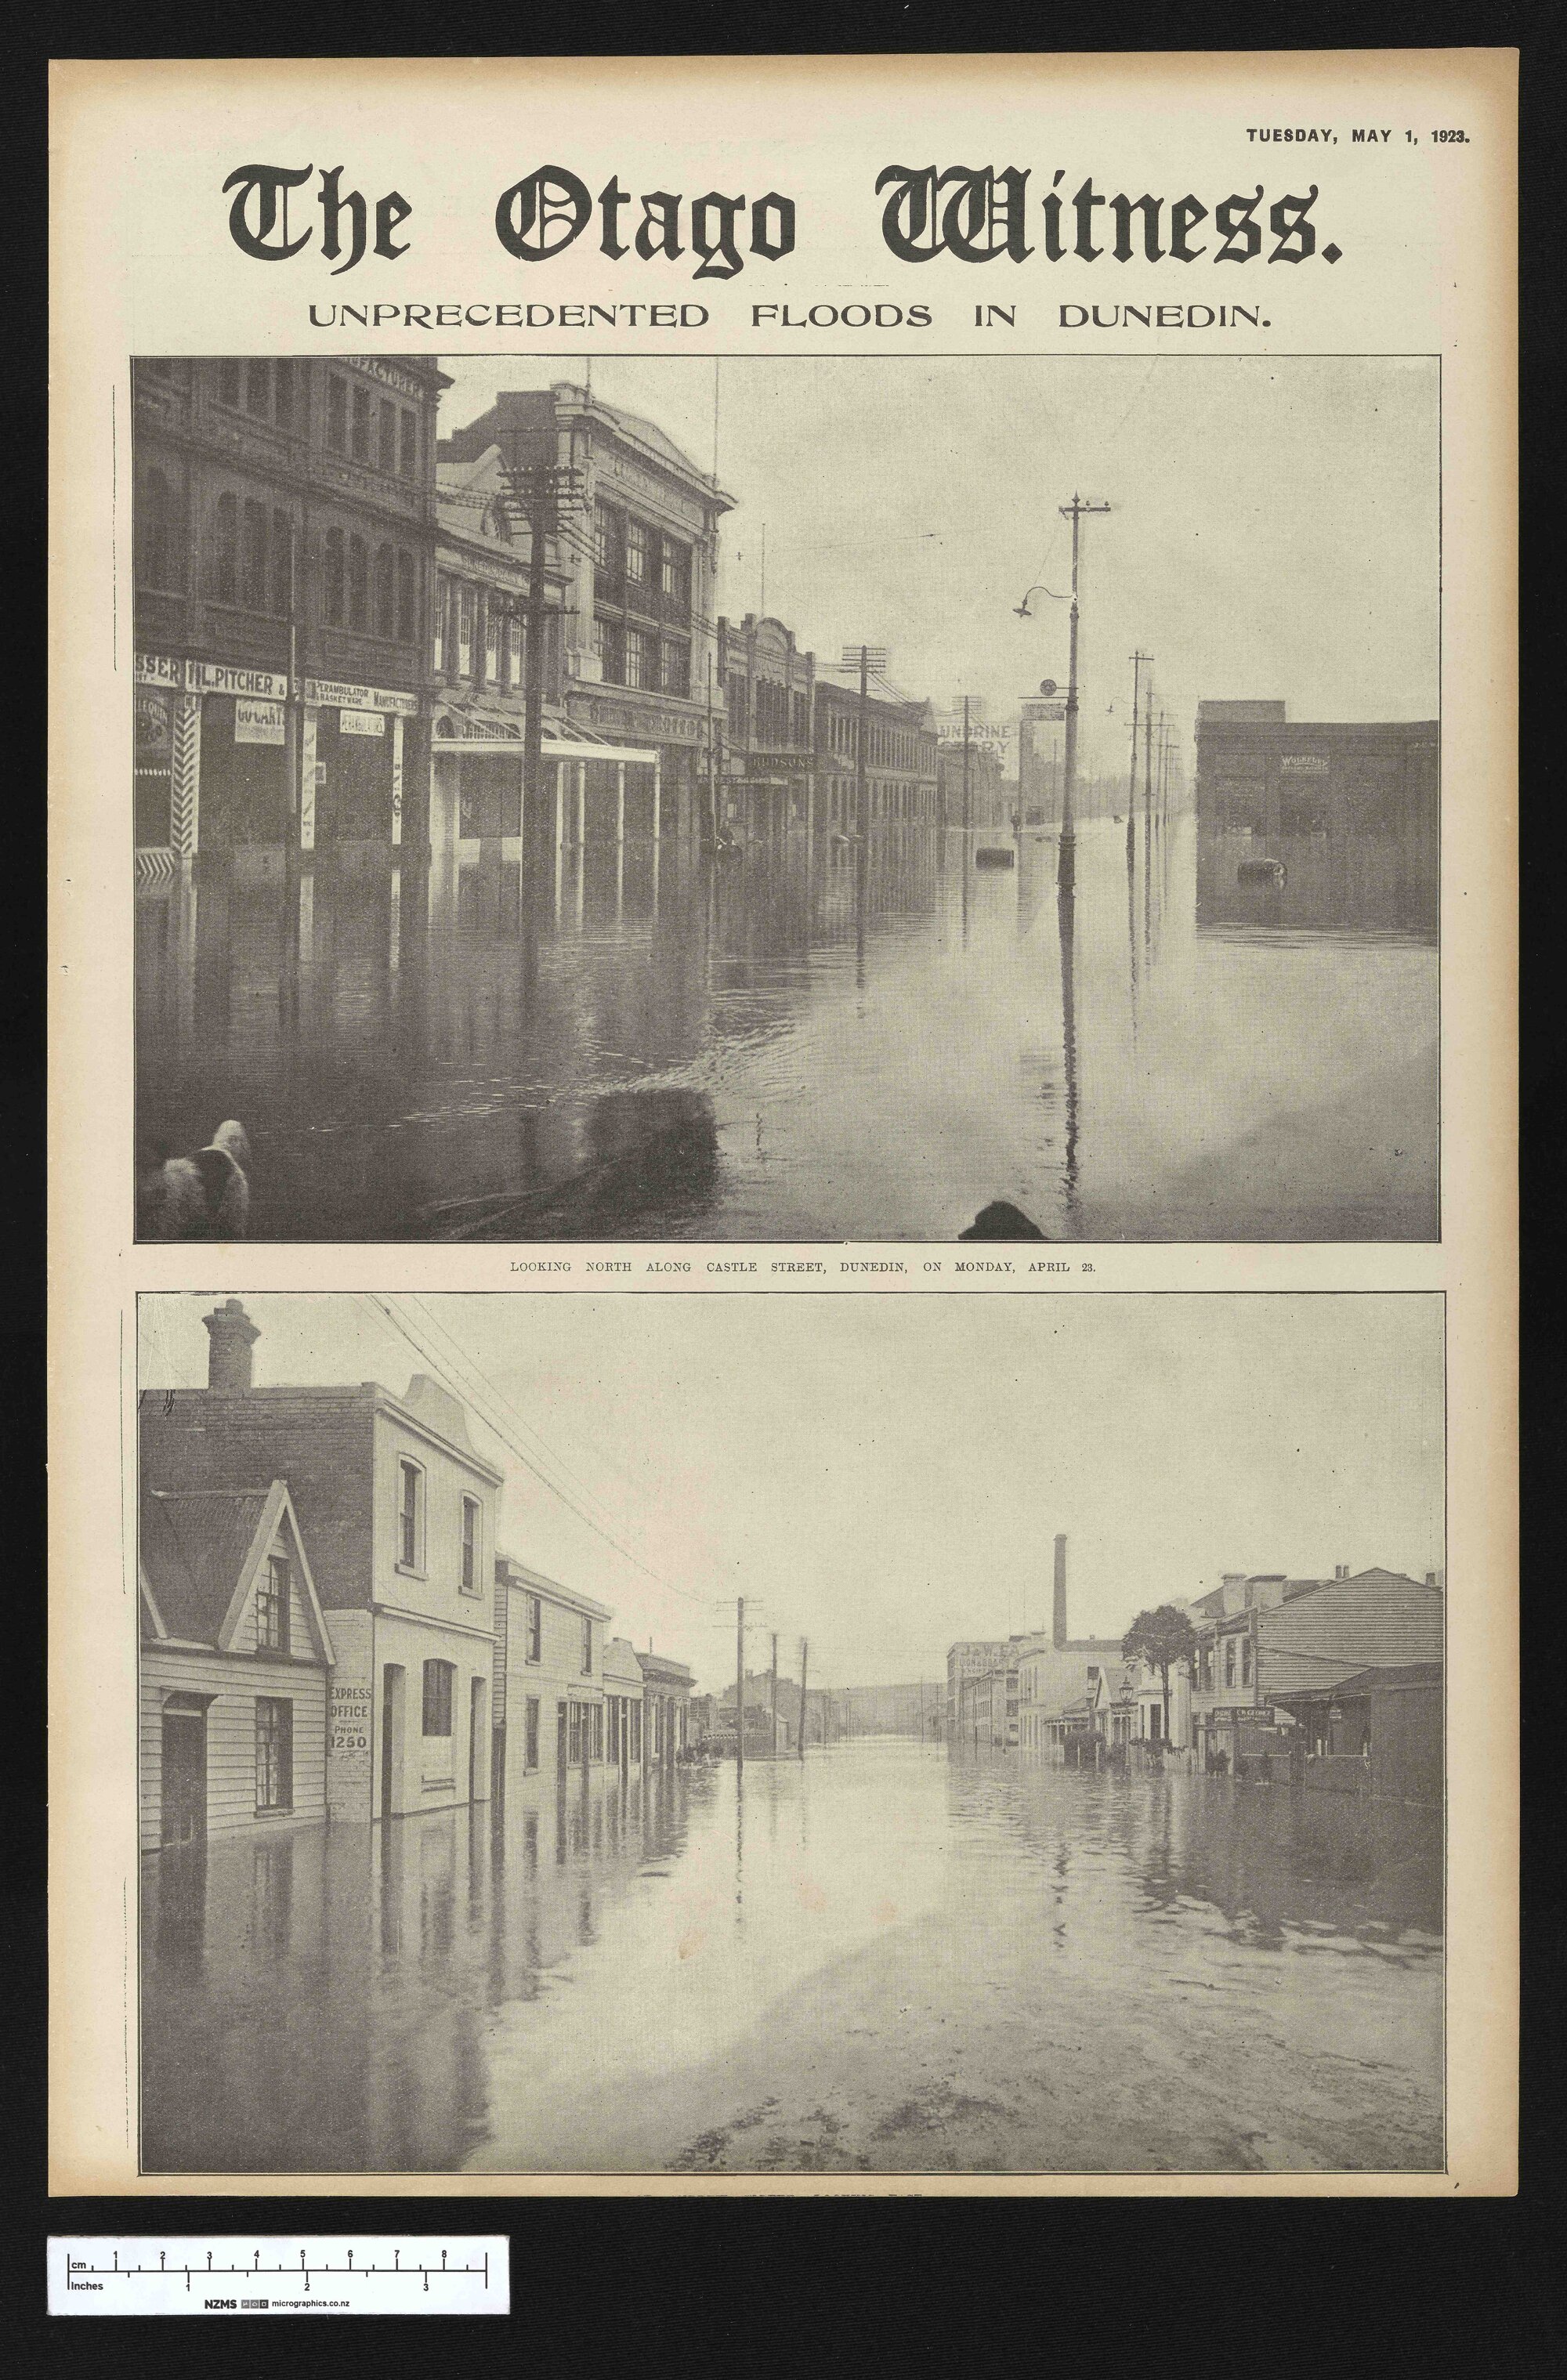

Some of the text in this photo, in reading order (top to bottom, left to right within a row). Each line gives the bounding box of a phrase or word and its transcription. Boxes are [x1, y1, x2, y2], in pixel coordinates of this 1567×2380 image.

[1247, 128, 1471, 145] TUESDAY, MAY 1, 1923.
[222, 163, 1343, 280] The Otago Witness.
[309, 304, 1272, 329] UNPRECEDENTED FLOODS IN DUNEDIN.
[278, 683, 285, 696] &
[316, 680, 370, 698] PERAMBULATOR
[510, 1262, 1096, 1275] LOOKING NORTH ALONG CASTLE STREET, DUNEDIN, ON MONDAY, APRIL 23.
[328, 1687, 371, 1700] EXPRESS
[330, 1705, 367, 1718] OFFICE
[335, 1725, 364, 1734] PHONE
[330, 1736, 367, 1749] 1250
[160, 2251, 166, 2260] 2
[207, 2251, 212, 2260] 3
[253, 2249, 260, 2259] 4
[300, 2249, 306, 2259] 5
[347, 2249, 353, 2259] 6
[394, 2249, 400, 2259] 7
[441, 2249, 447, 2259] 8
[71, 2281, 103, 2291] Inches
[304, 2283, 310, 2292] 2
[423, 2283, 429, 2292] 3
[204, 2299, 350, 2309] NZMS micrographics.co.nz
